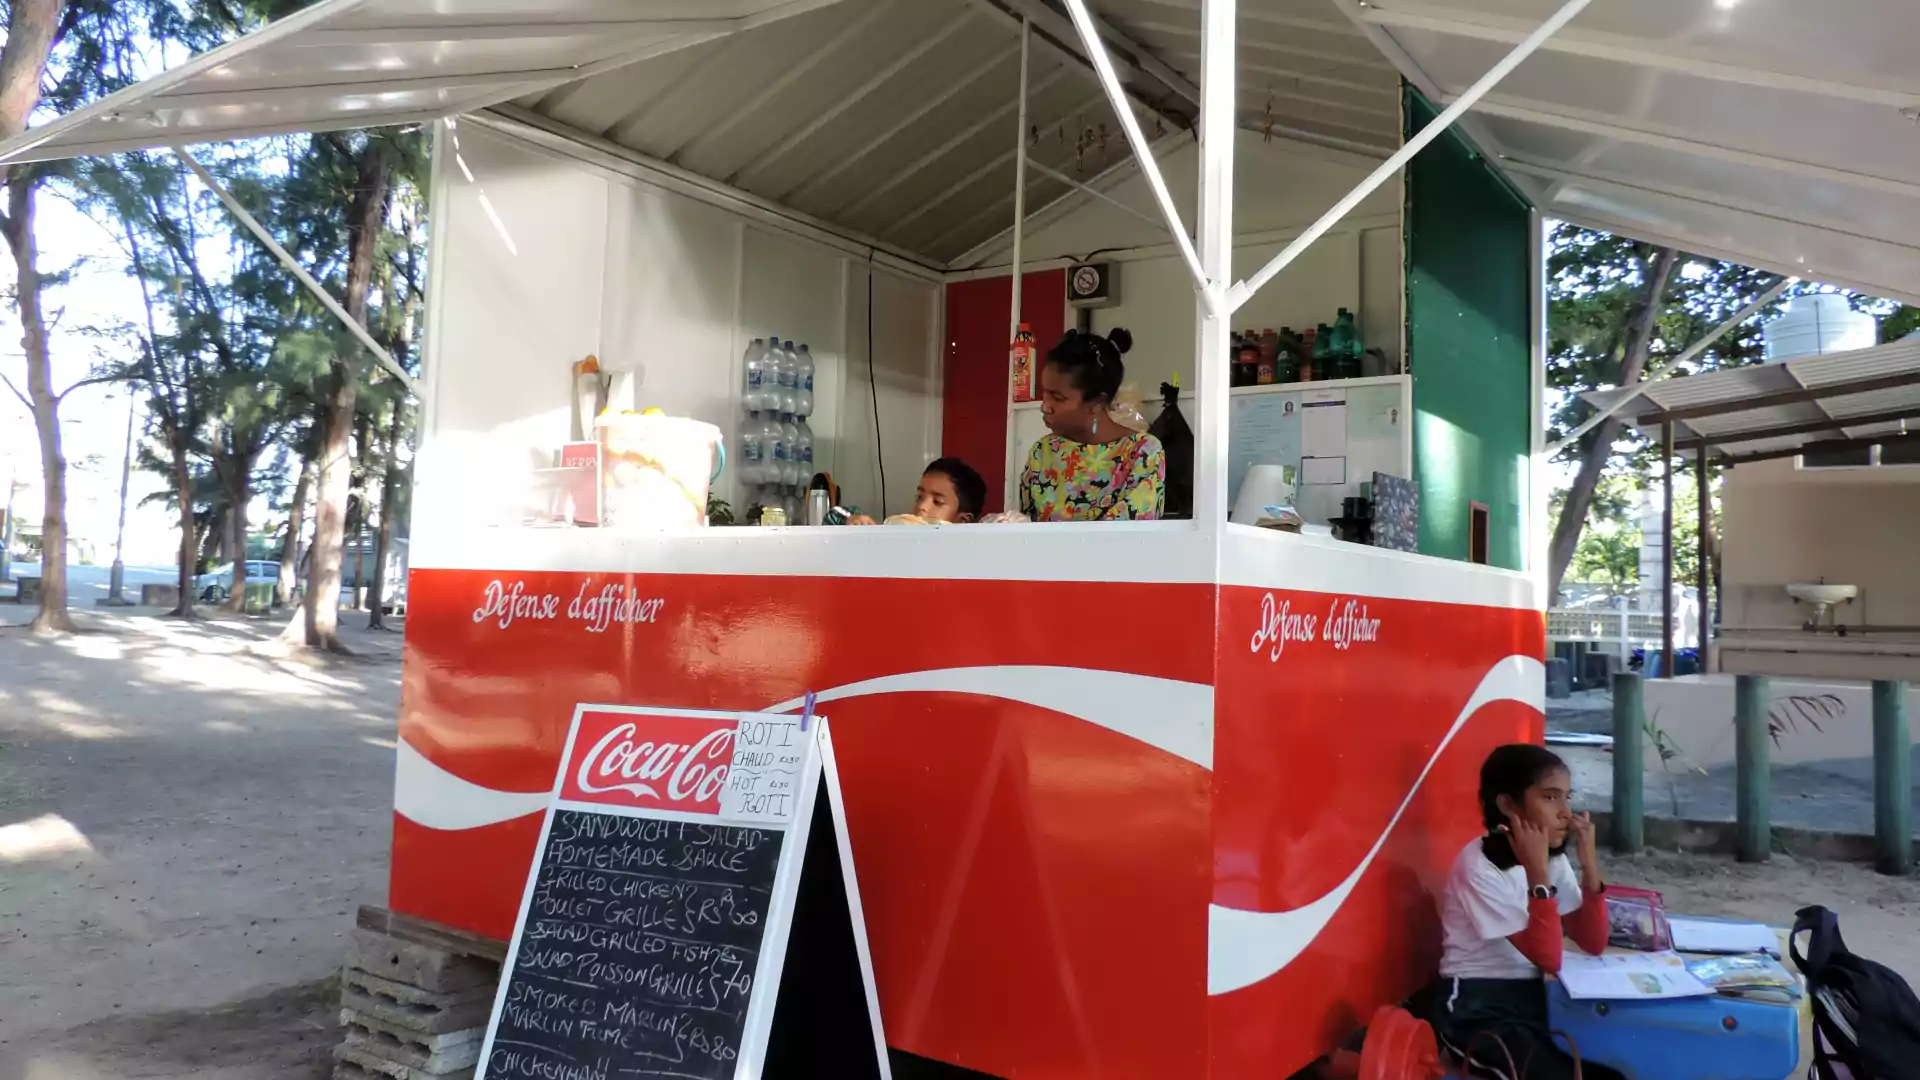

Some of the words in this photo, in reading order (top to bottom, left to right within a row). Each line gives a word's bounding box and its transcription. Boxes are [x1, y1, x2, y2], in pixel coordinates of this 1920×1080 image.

[472, 580, 560, 630] Défense
[567, 576, 665, 632] d'afficher
[1251, 592, 1317, 662] Défense
[1323, 598, 1381, 650] d'afficher
[740, 721, 797, 747] ROTI
[577, 723, 737, 802] Coca-Co
[732, 750, 775, 767] CHAUD
[730, 776, 761, 791] HOT
[738, 793, 790, 816] ROTI
[549, 842, 667, 869] HOMEMADE
[672, 844, 748, 872] SAUCE
[537, 866, 606, 892] GRILLED
[609, 877, 684, 900] CHICKEN
[590, 929, 666, 954] GRILLED
[672, 942, 711, 962] FISH
[577, 952, 648, 984] POISSON
[501, 1002, 573, 1037] MARLIN
[509, 981, 596, 1014] SMOKED
[604, 1002, 678, 1037] MARLIN
